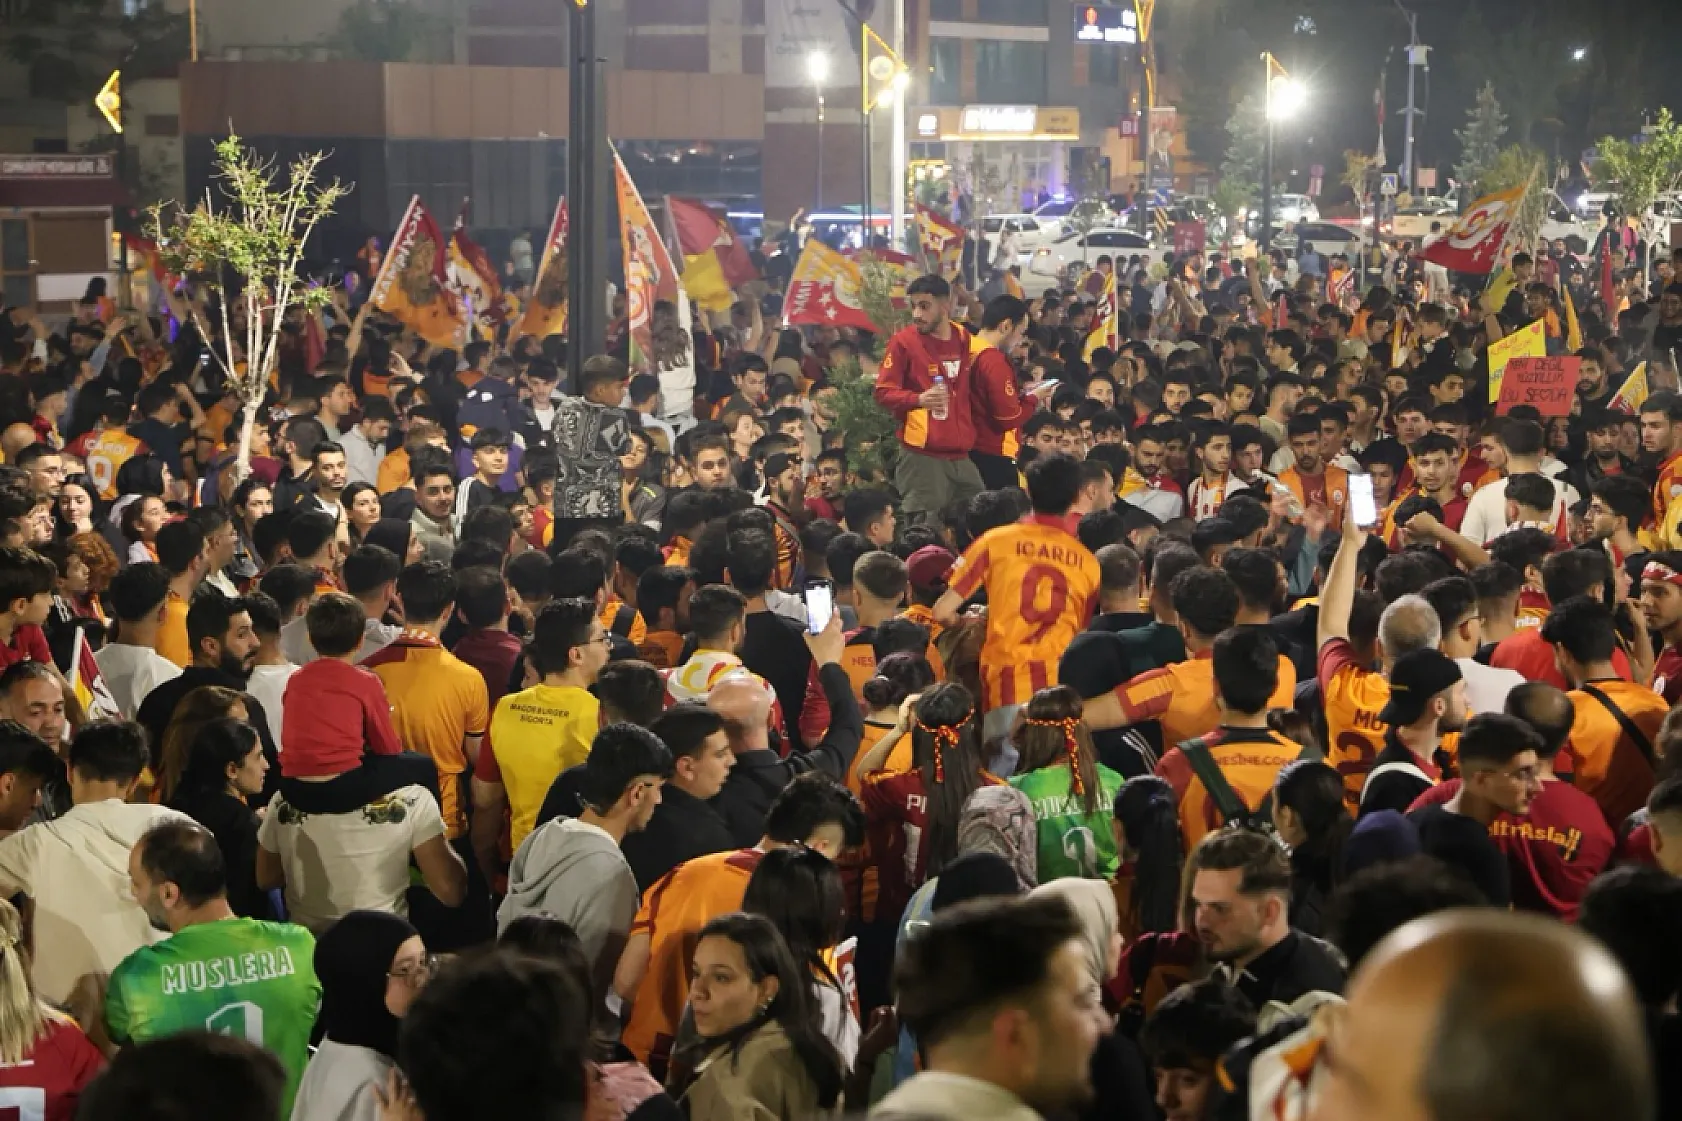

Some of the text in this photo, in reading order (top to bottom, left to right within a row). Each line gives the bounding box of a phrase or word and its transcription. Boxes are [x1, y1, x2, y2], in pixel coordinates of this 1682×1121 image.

[1015, 540, 1084, 570] ICARDI
[1020, 563, 1068, 645] 9
[161, 945, 296, 995] MUSLERA
